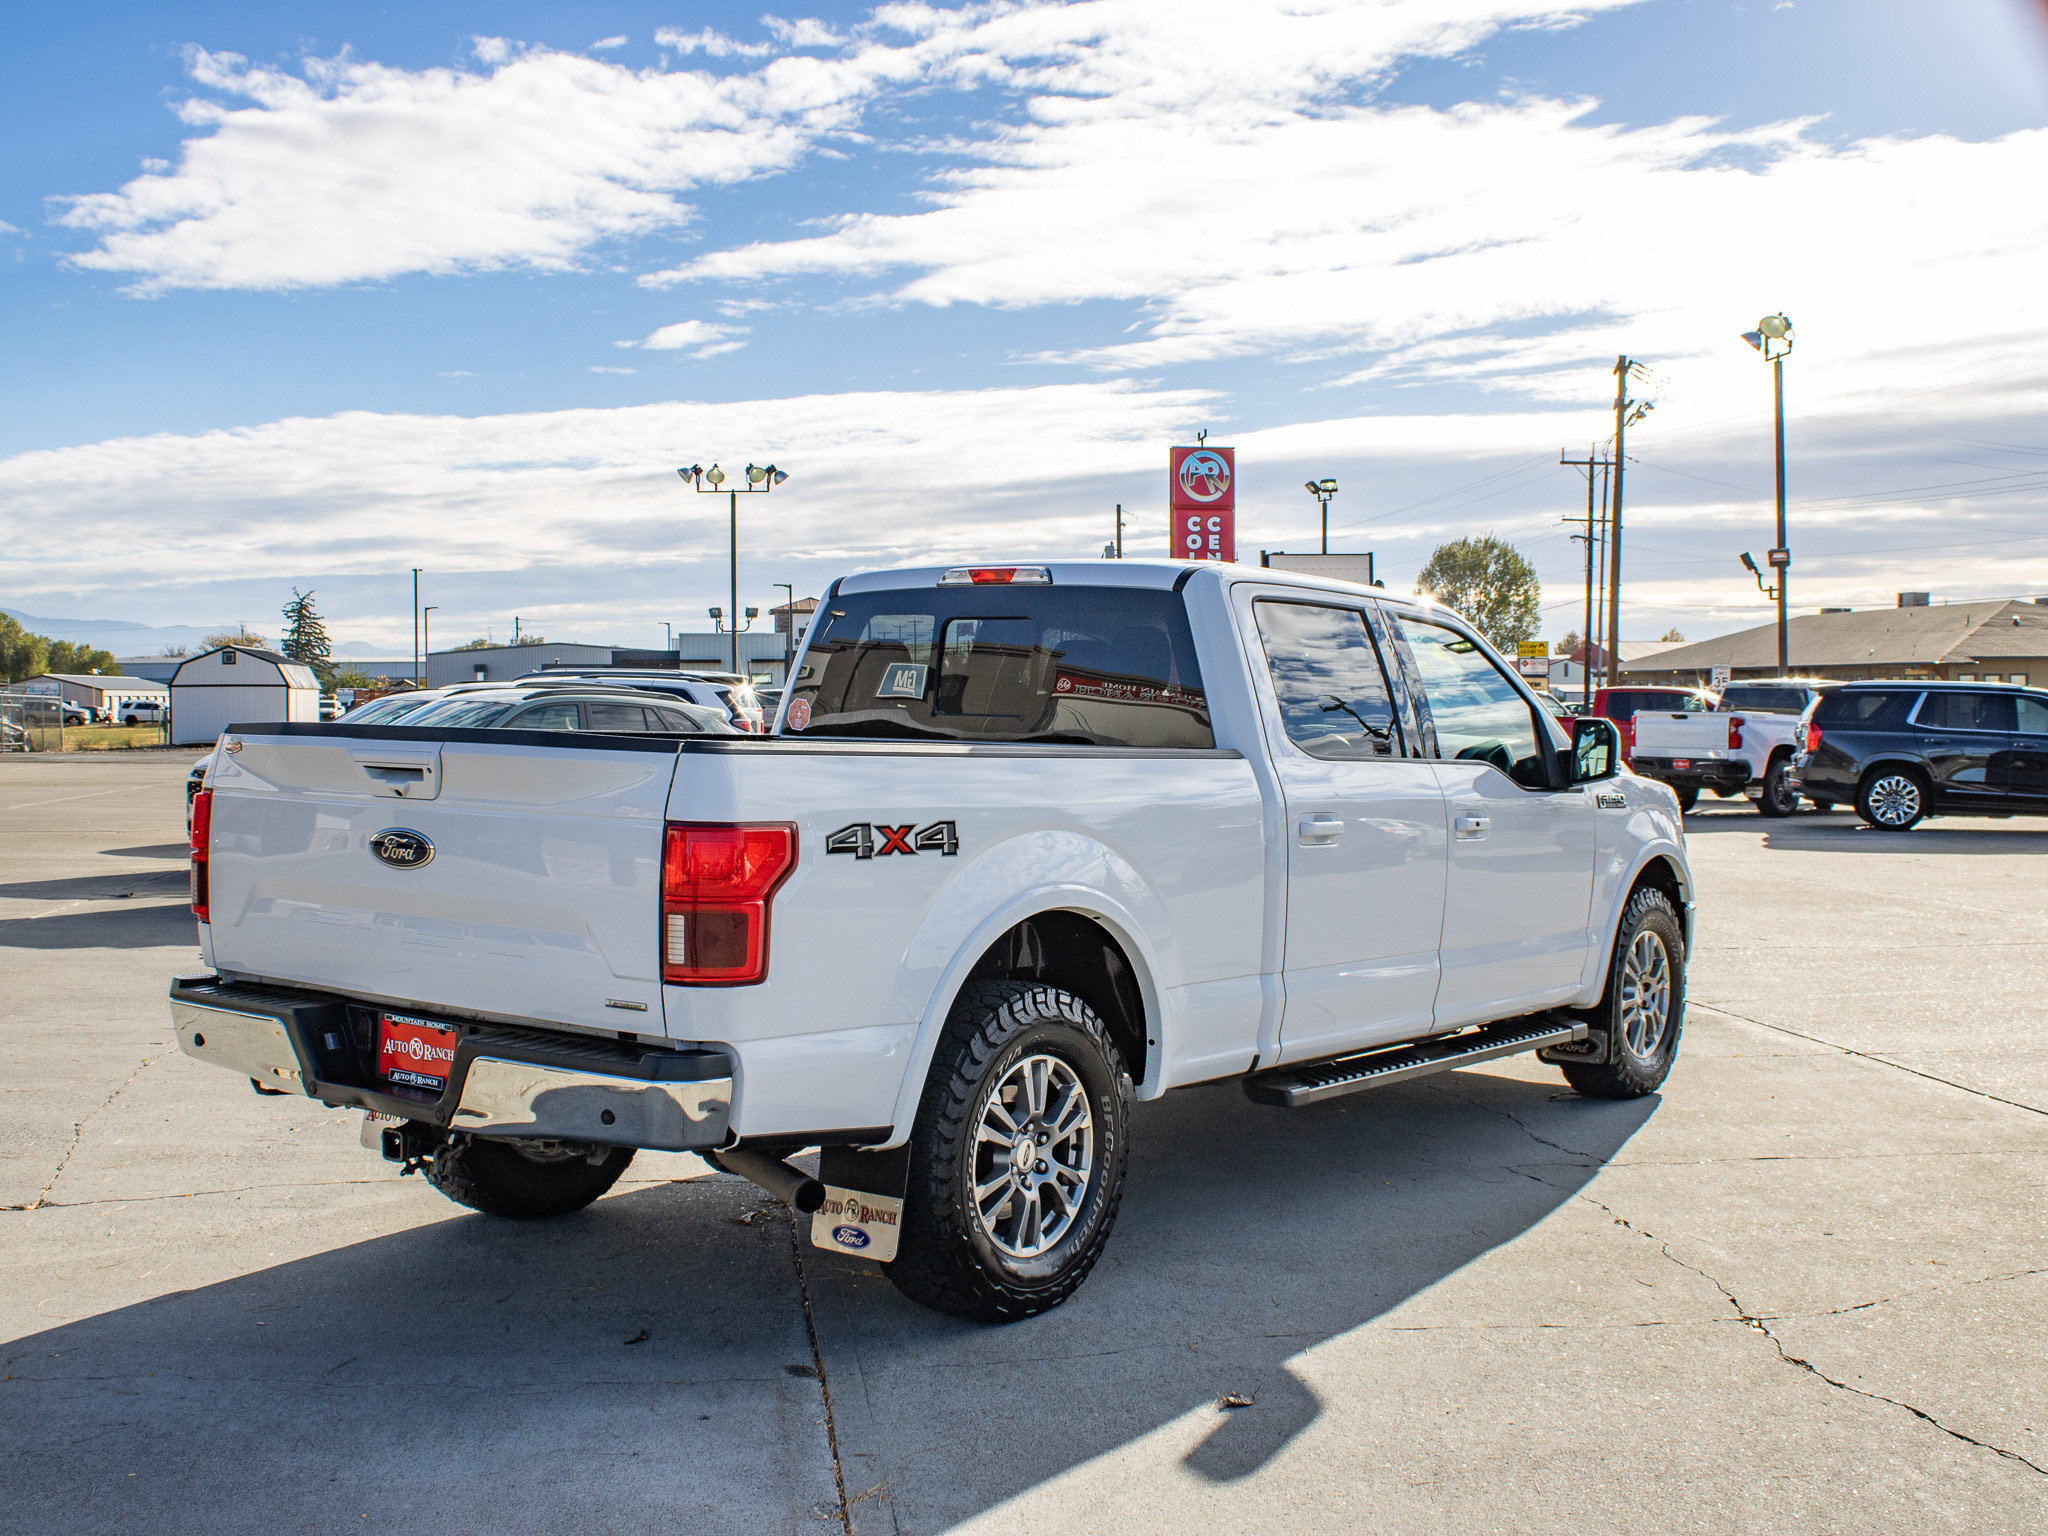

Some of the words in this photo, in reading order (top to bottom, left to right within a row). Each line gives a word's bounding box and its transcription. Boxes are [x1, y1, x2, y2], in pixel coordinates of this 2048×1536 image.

[381, 836, 417, 860] Ford
[383, 1038, 409, 1055] AUTO
[423, 1044, 455, 1062] RANCH
[416, 1075, 438, 1086] RANCH
[860, 1205, 897, 1225] RANCH
[837, 1228, 864, 1245] Ford
